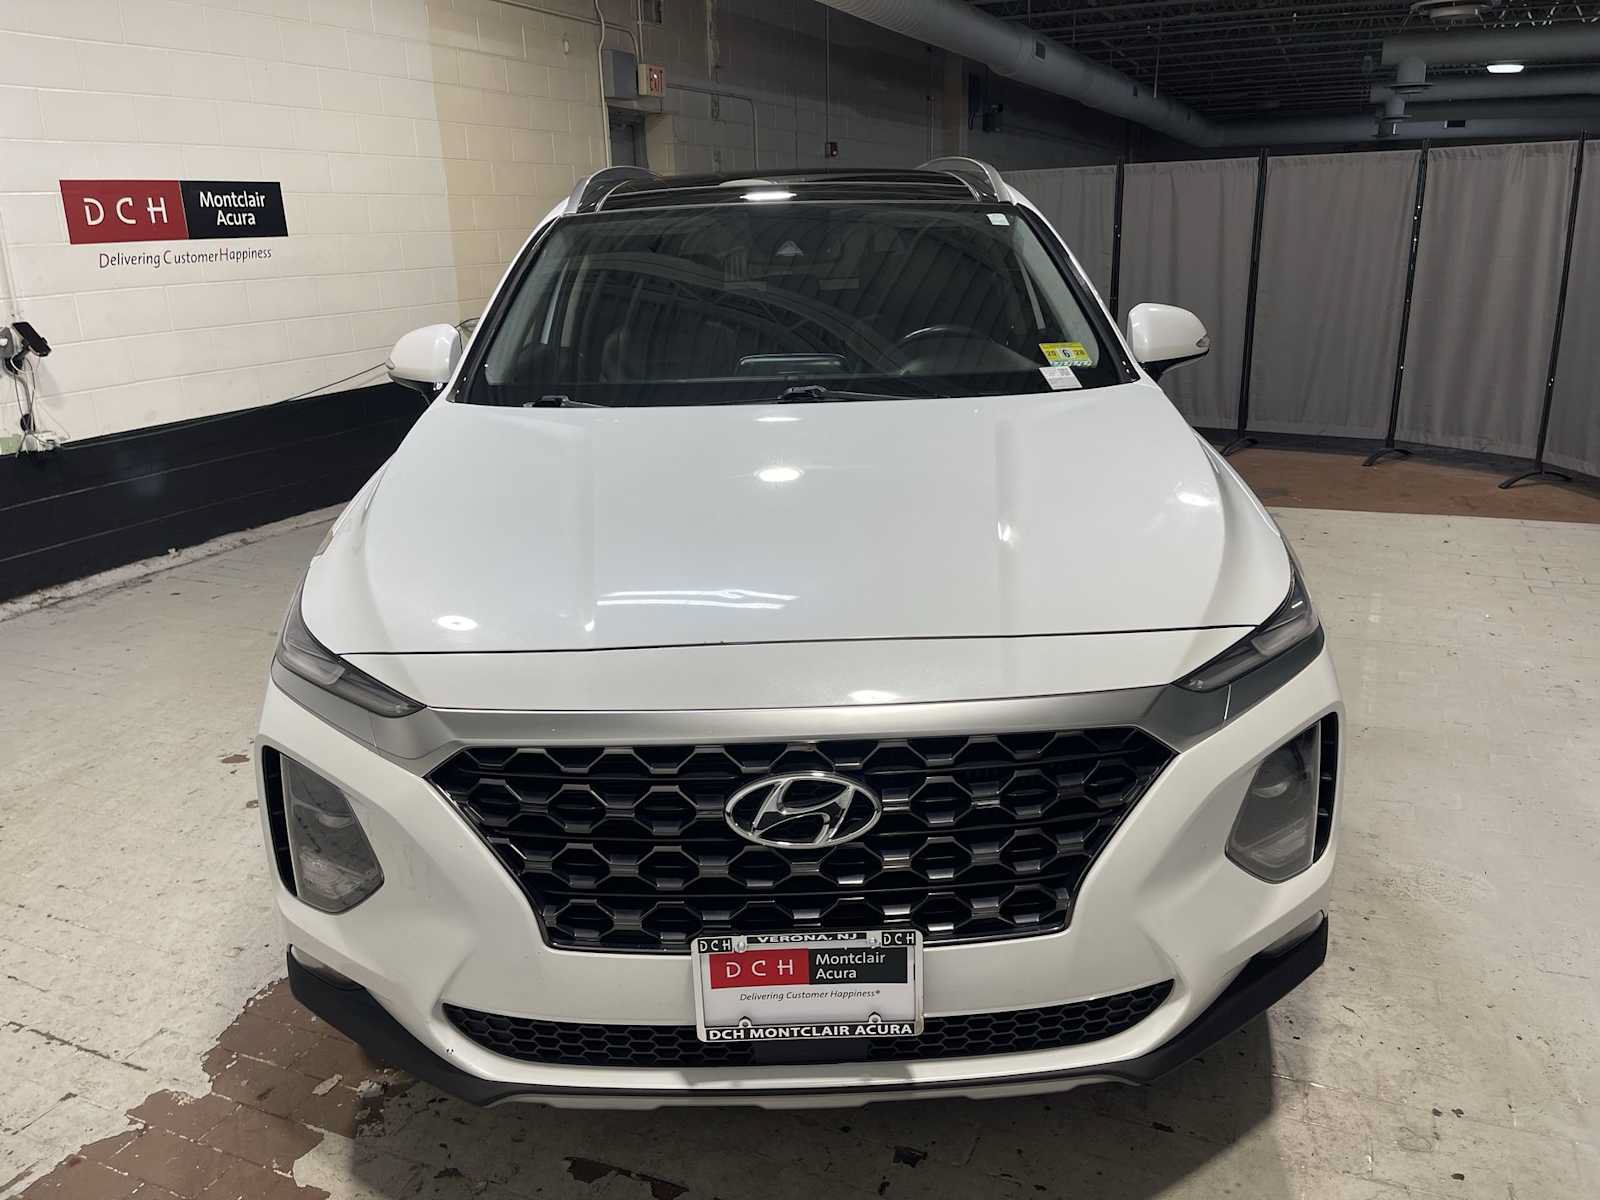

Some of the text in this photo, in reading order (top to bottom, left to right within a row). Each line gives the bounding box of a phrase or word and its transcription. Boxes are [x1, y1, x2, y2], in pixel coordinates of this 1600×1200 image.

[199, 190, 266, 208] Montclair
[216, 210, 256, 226] Acura
[99, 250, 161, 269] Delivering
[757, 933, 832, 943] VERONA,
[837, 932, 858, 940] NJ
[815, 952, 886, 965] Montclair
[815, 967, 857, 980] Acura
[739, 991, 784, 1001] Delivering
[785, 990, 828, 1000] Customer
[708, 1023, 913, 1041] DCH MONTCLAIR ACURA
